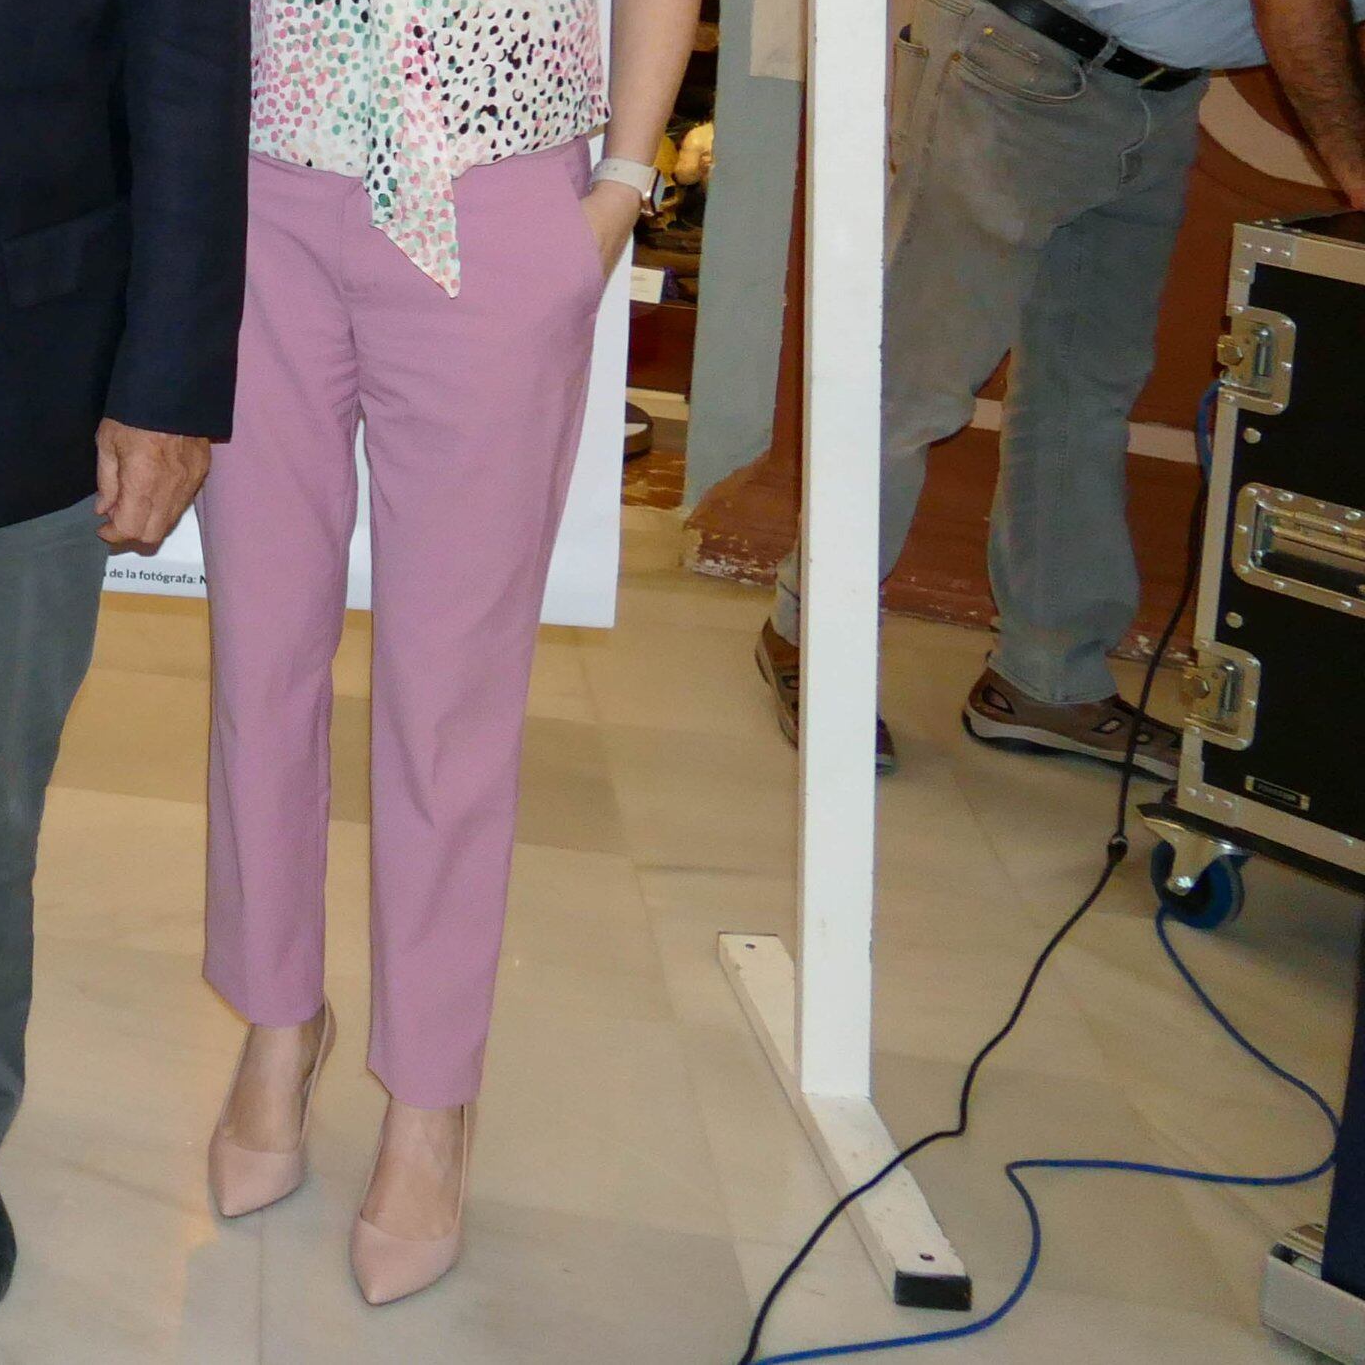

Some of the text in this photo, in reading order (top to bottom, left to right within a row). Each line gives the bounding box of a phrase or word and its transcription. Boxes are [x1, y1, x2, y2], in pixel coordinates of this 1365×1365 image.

[109, 568, 124, 579] de
[126, 569, 137, 580] la
[139, 570, 197, 585] fotógrafa:
